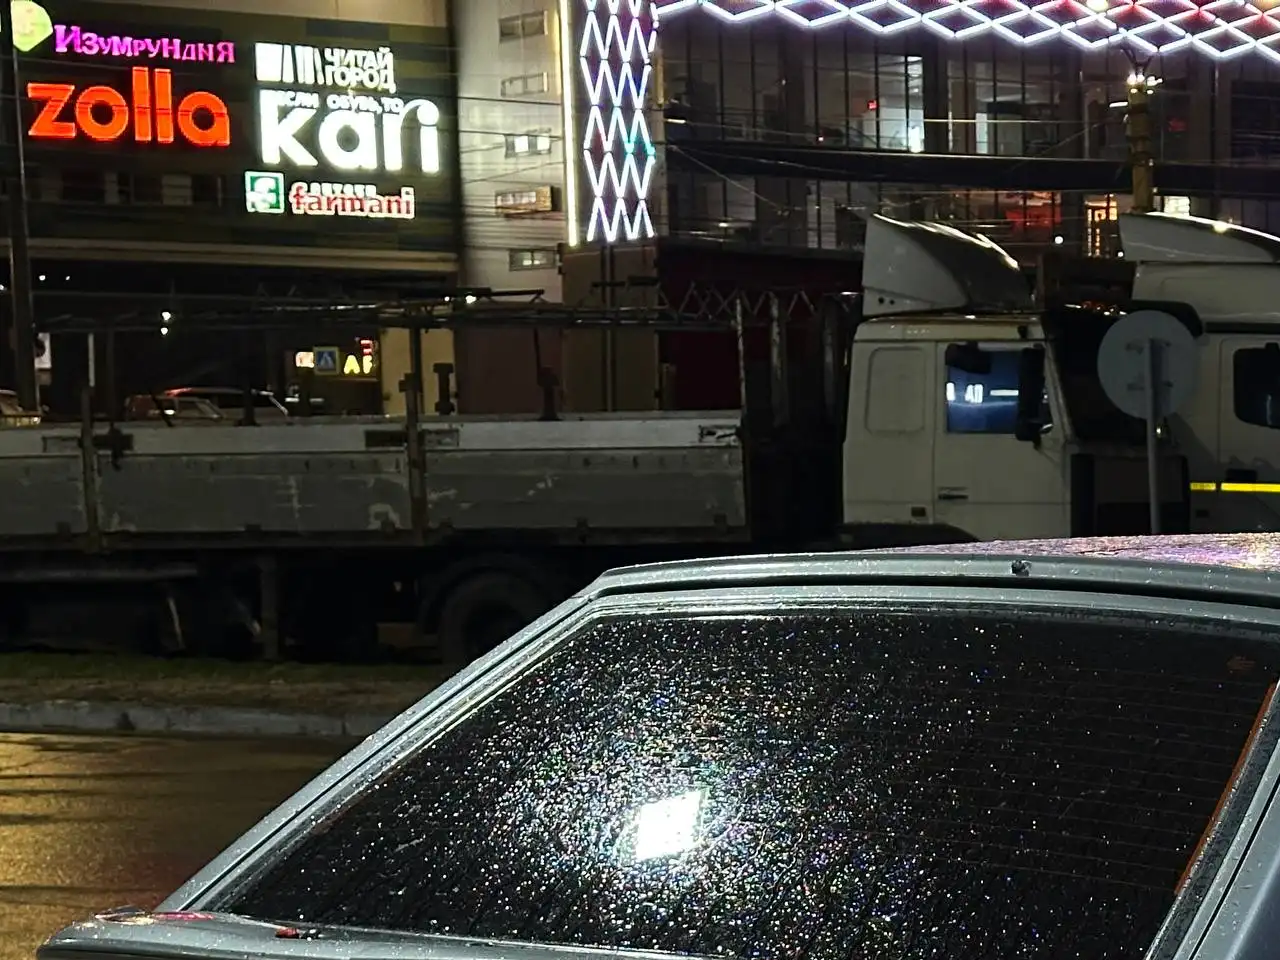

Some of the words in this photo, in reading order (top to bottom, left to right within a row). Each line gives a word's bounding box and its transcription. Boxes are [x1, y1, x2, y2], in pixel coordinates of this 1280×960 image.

[325, 46, 394, 70] ЧИТАЙ
[325, 64, 397, 94] ГОРОД
[27, 66, 231, 146] zolla
[259, 88, 441, 174] kari
[289, 184, 414, 218] farmani
